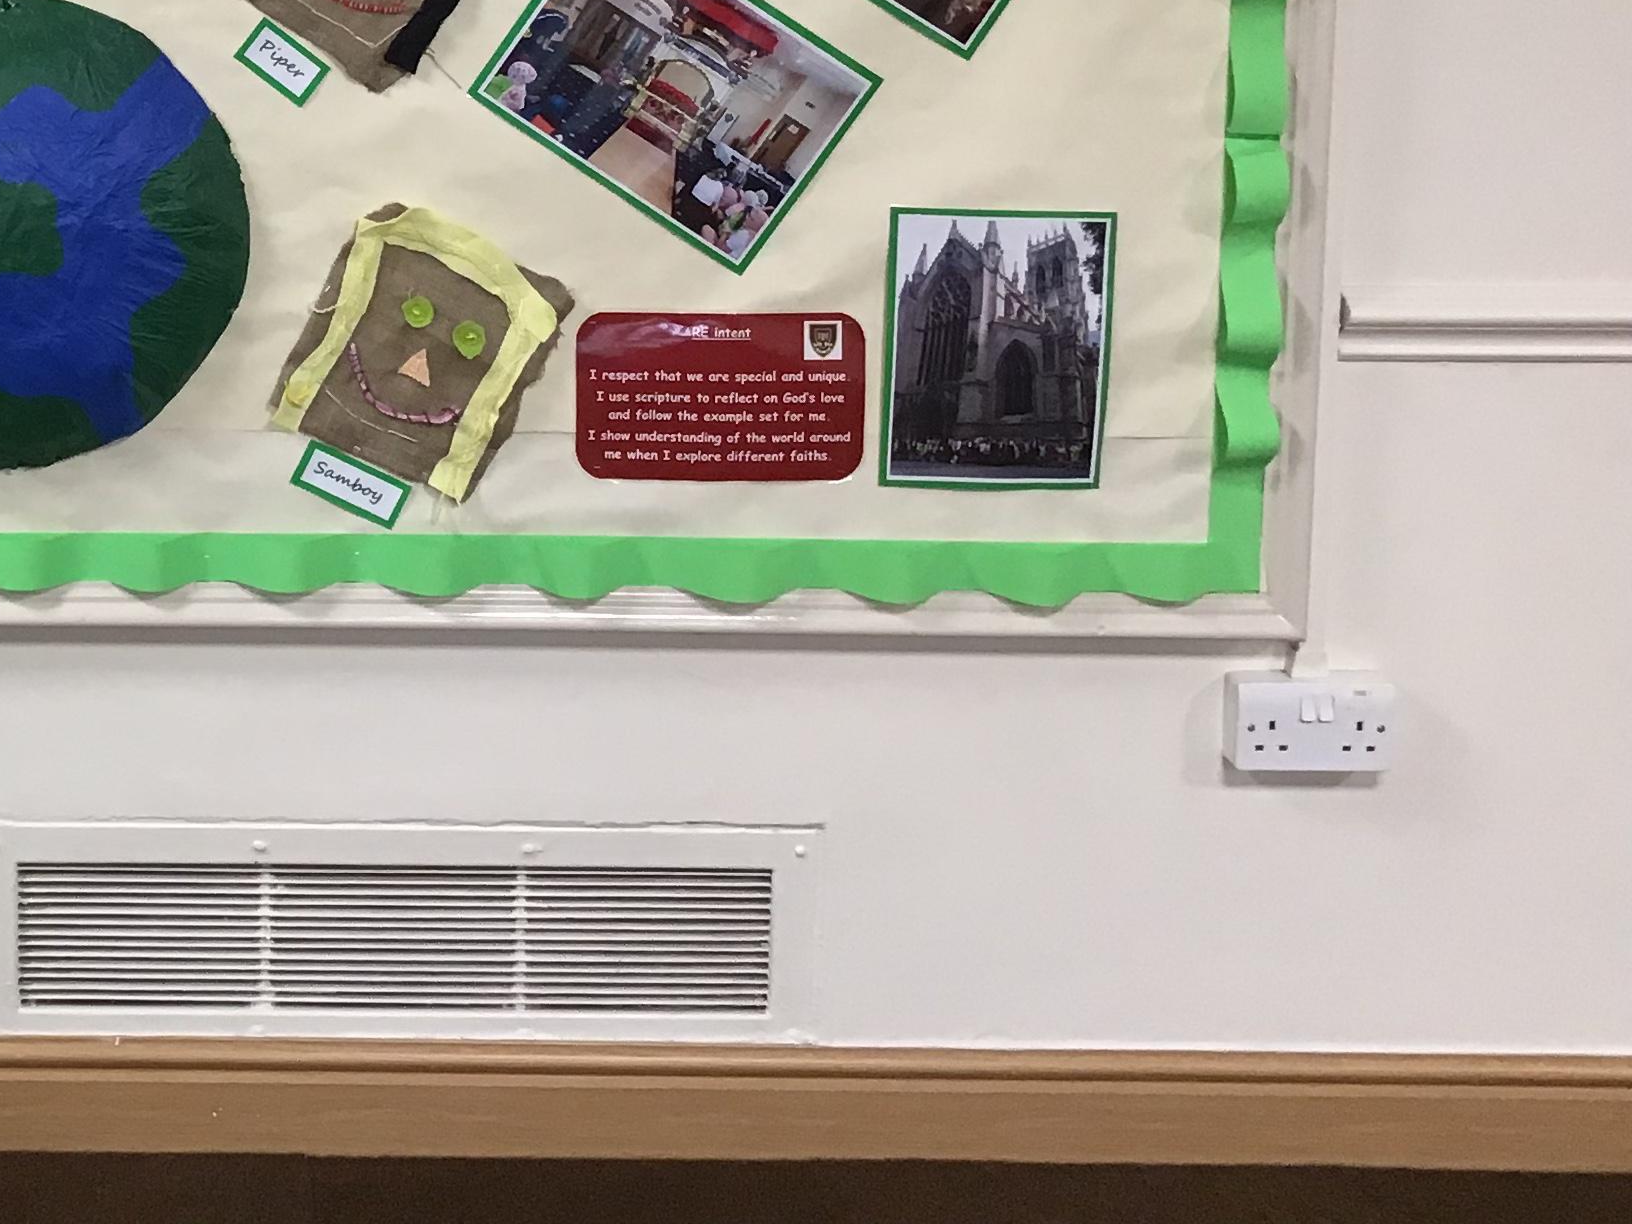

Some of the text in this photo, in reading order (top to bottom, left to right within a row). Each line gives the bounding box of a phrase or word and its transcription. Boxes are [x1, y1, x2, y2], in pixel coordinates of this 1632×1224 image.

[259, 39, 305, 77] Piper
[714, 326, 752, 338] intent
[589, 369, 597, 380] I
[602, 370, 649, 384] respect
[654, 370, 682, 382] that
[686, 373, 704, 382] we
[708, 373, 730, 382] are
[735, 370, 776, 385] special
[781, 371, 803, 382] and
[596, 391, 845, 405] I use scripture to reflect on God's love
[608, 409, 630, 420] and
[635, 409, 672, 421] follow
[677, 410, 698, 422] the
[703, 410, 754, 424] example
[759, 411, 778, 422] set
[784, 411, 804, 422] for
[588, 430, 851, 446] I show understanding of the world around
[604, 451, 622, 460] me
[627, 450, 658, 461] when
[662, 449, 670, 460] I
[675, 450, 722, 464] explore
[726, 451, 784, 462] different
[313, 461, 383, 505] Samboy
